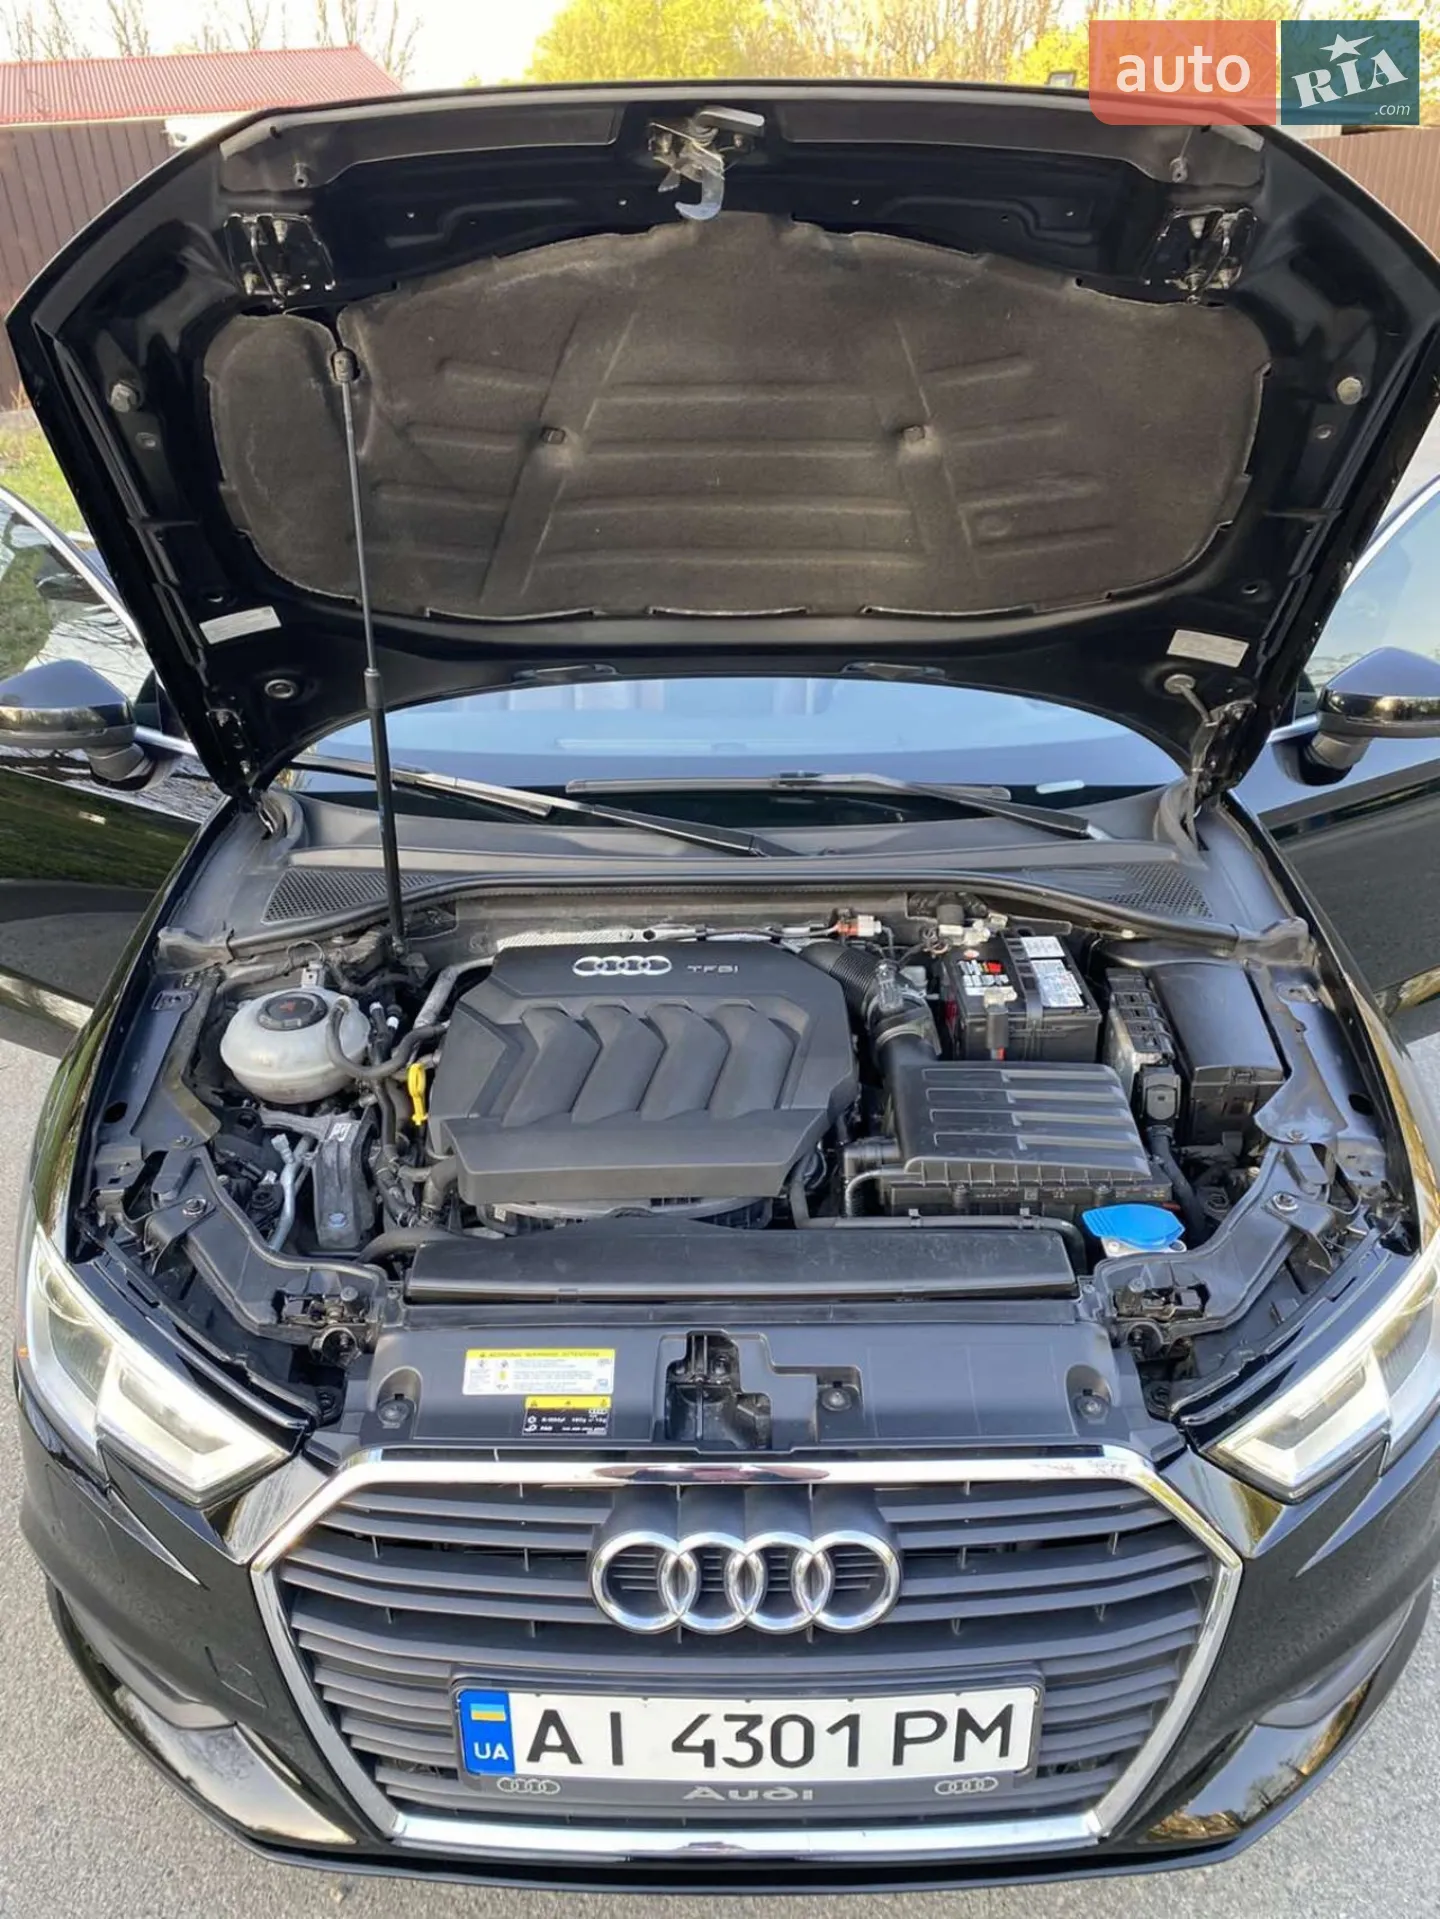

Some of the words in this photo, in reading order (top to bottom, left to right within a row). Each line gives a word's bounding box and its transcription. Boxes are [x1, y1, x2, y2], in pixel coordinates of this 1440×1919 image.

[671, 1713, 861, 1769] 4301
[892, 1703, 1014, 1766] PM
[473, 1742, 509, 1761] UA
[683, 1786, 813, 1801] Audi
